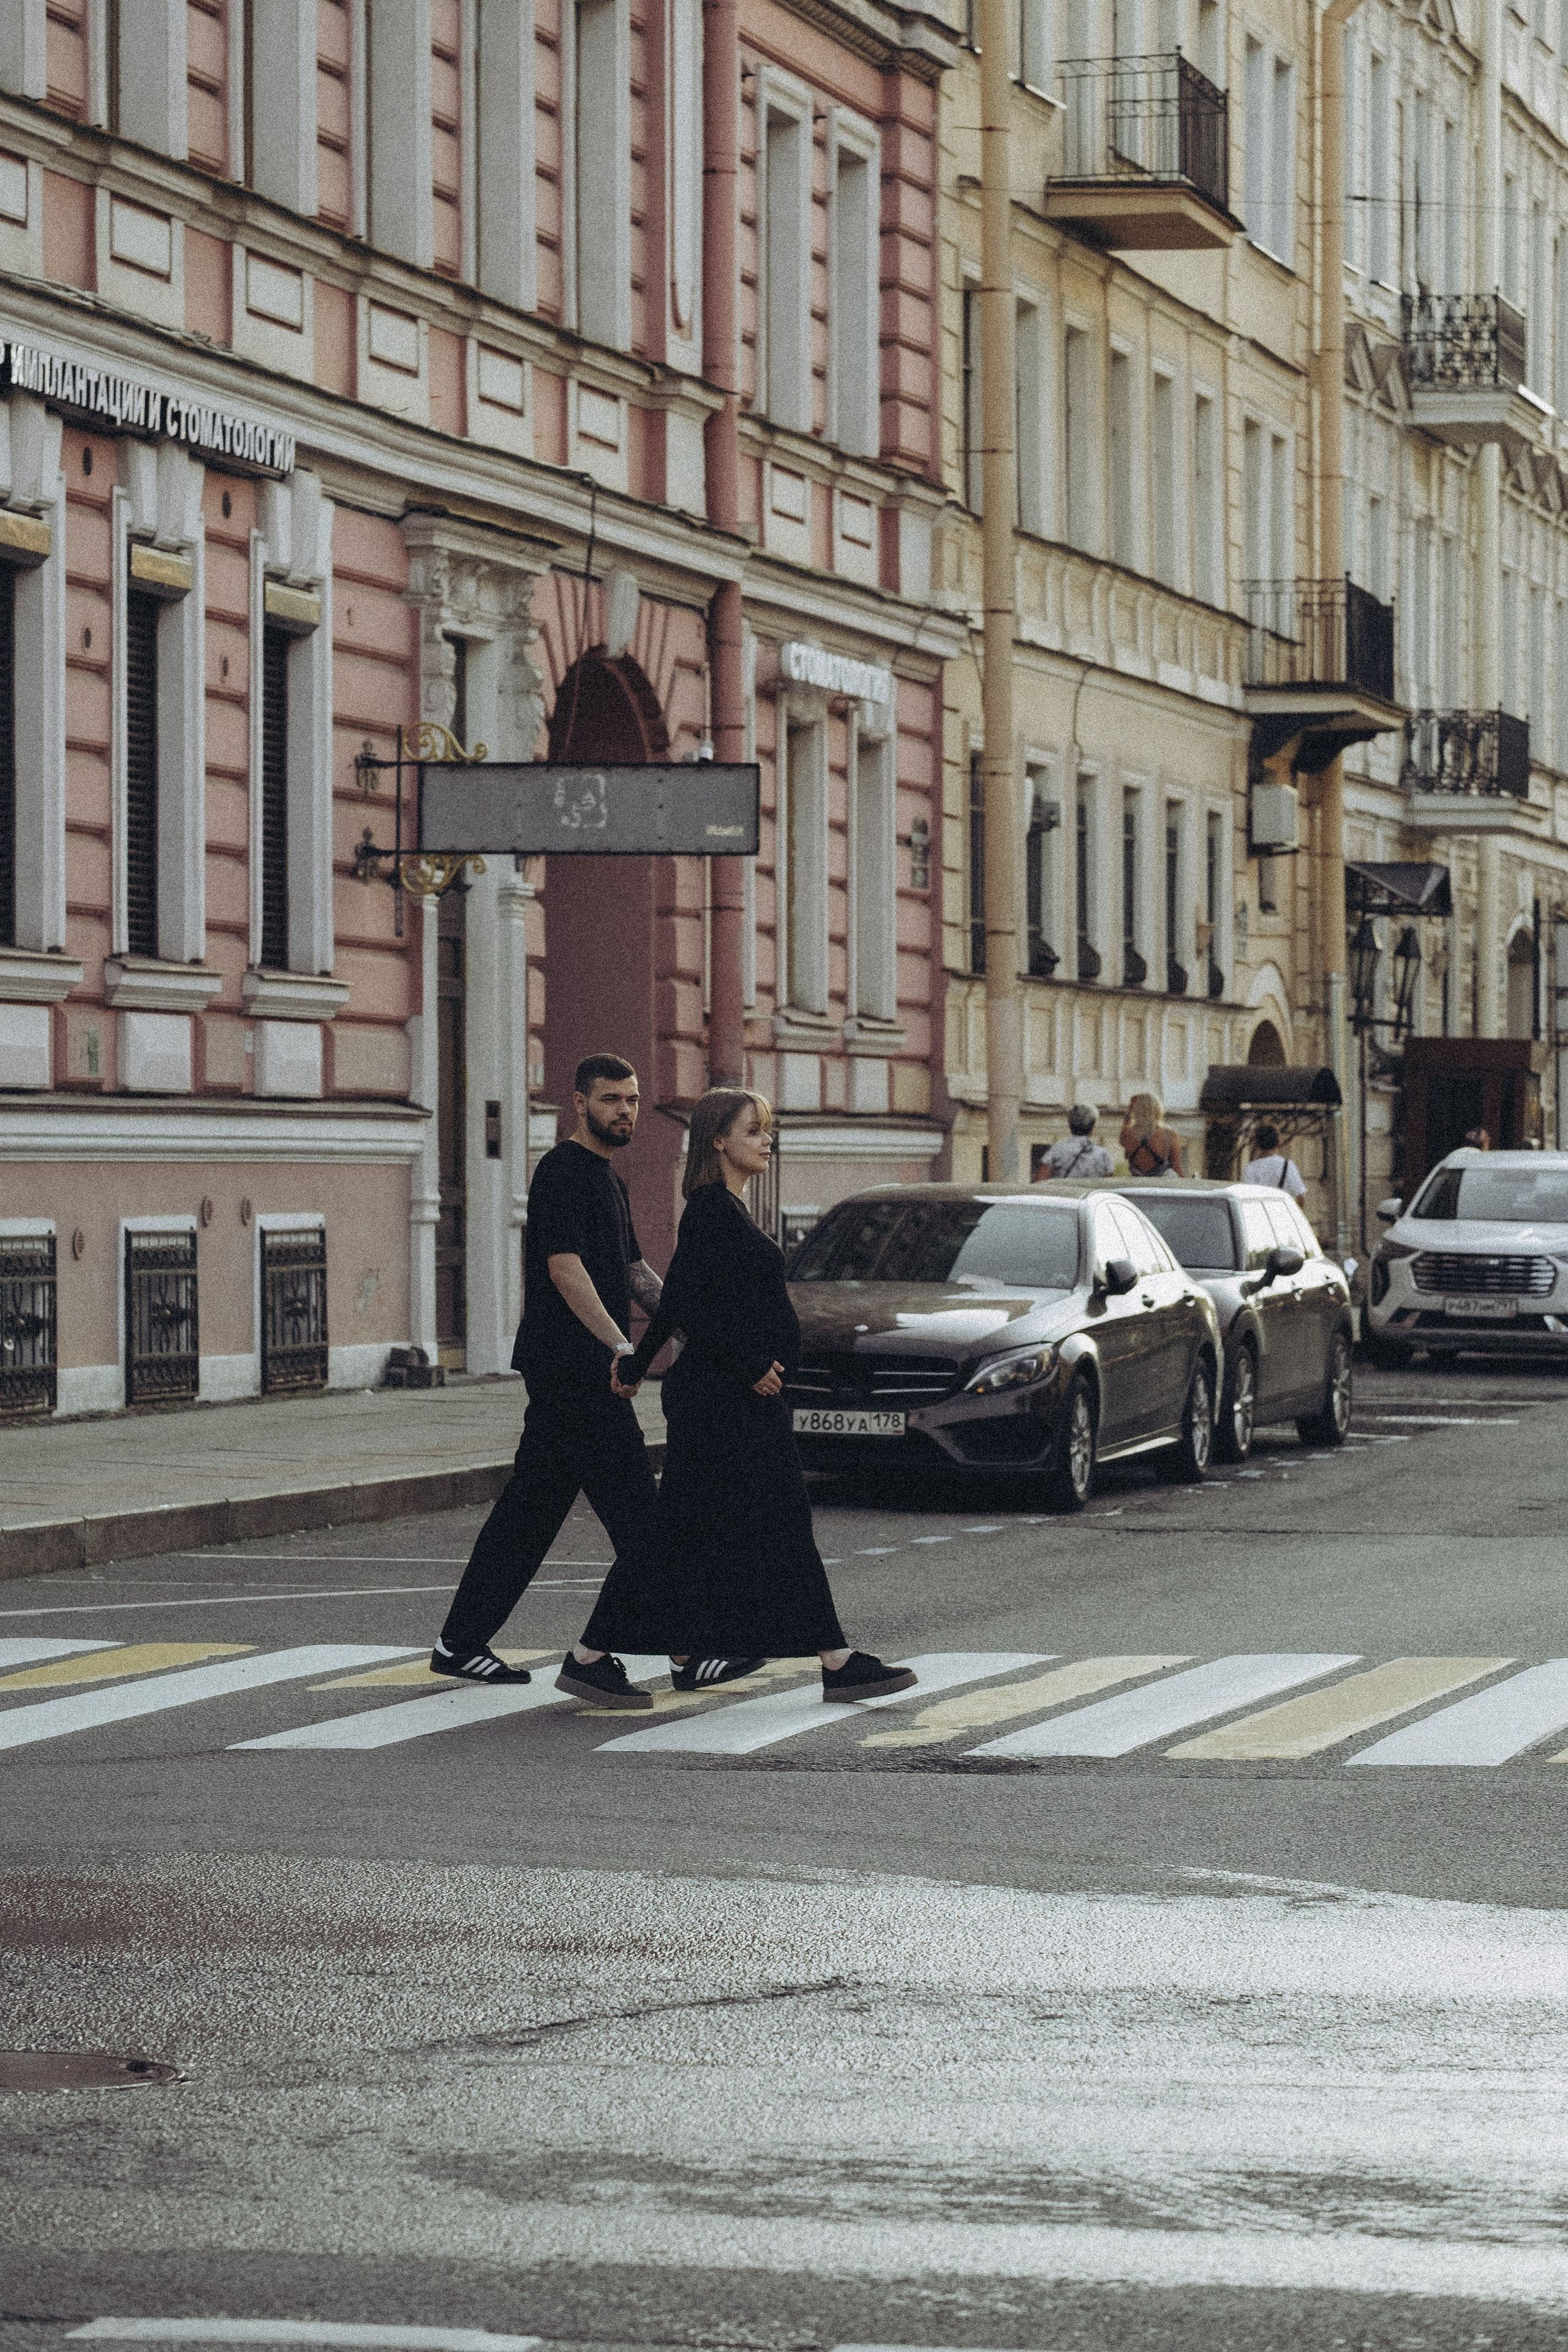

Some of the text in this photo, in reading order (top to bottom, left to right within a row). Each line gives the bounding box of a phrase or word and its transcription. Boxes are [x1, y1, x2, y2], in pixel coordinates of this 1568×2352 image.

[10, 345, 146, 426] ИМПЛАНТАЦИИ
[148, 390, 161, 431] И
[166, 398, 296, 473] СТОМАТОЛОГИИ
